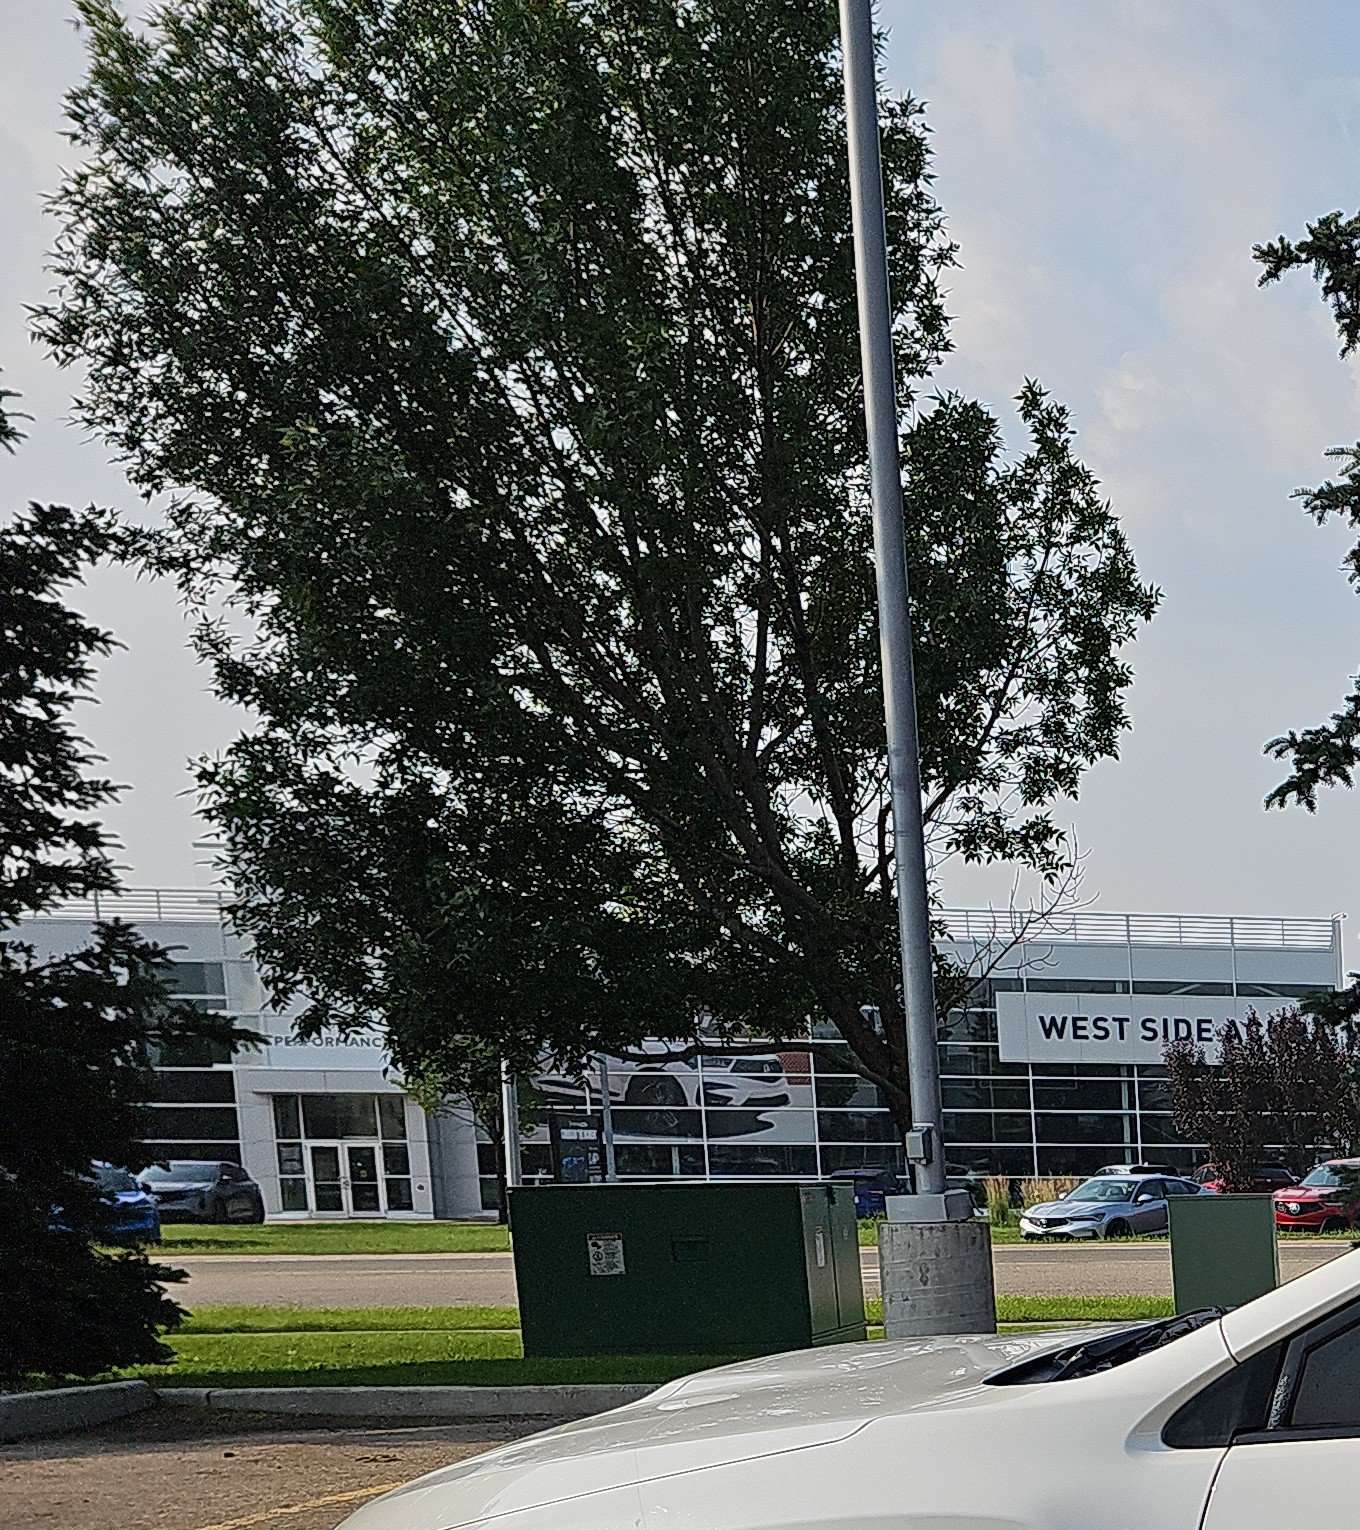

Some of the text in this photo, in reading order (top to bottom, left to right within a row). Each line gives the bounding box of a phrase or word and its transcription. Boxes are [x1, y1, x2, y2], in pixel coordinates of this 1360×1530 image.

[1038, 1015, 1130, 1041] WEST
[1141, 1017, 1213, 1043] SIDE
[274, 1035, 383, 1048] PEORMANC
